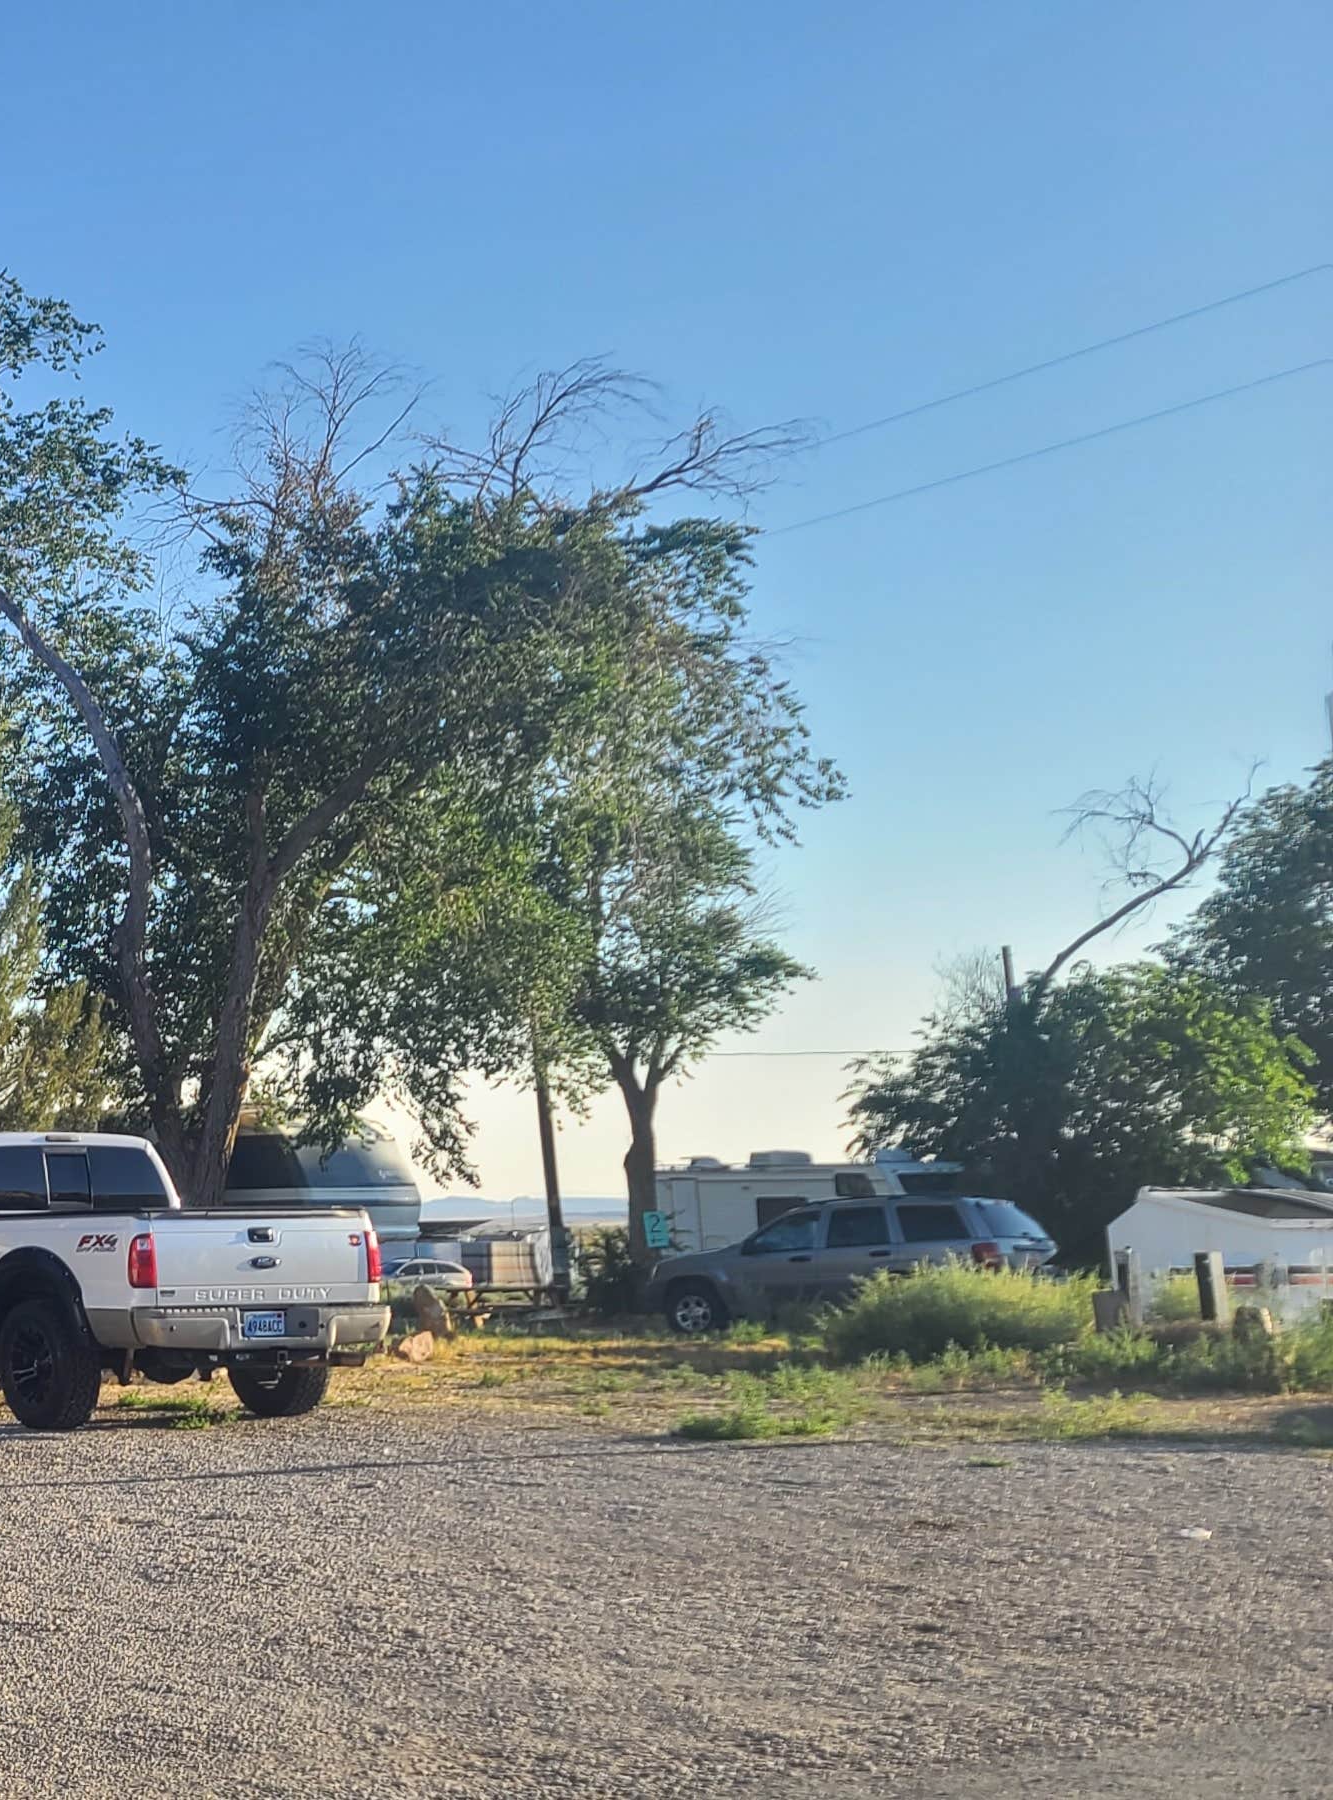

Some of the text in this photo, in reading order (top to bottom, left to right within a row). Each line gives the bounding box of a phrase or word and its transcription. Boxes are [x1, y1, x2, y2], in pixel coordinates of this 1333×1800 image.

[649, 1214, 662, 1232] 2
[78, 1234, 118, 1247] FX4
[195, 1287, 333, 1302] SUPER DUTY
